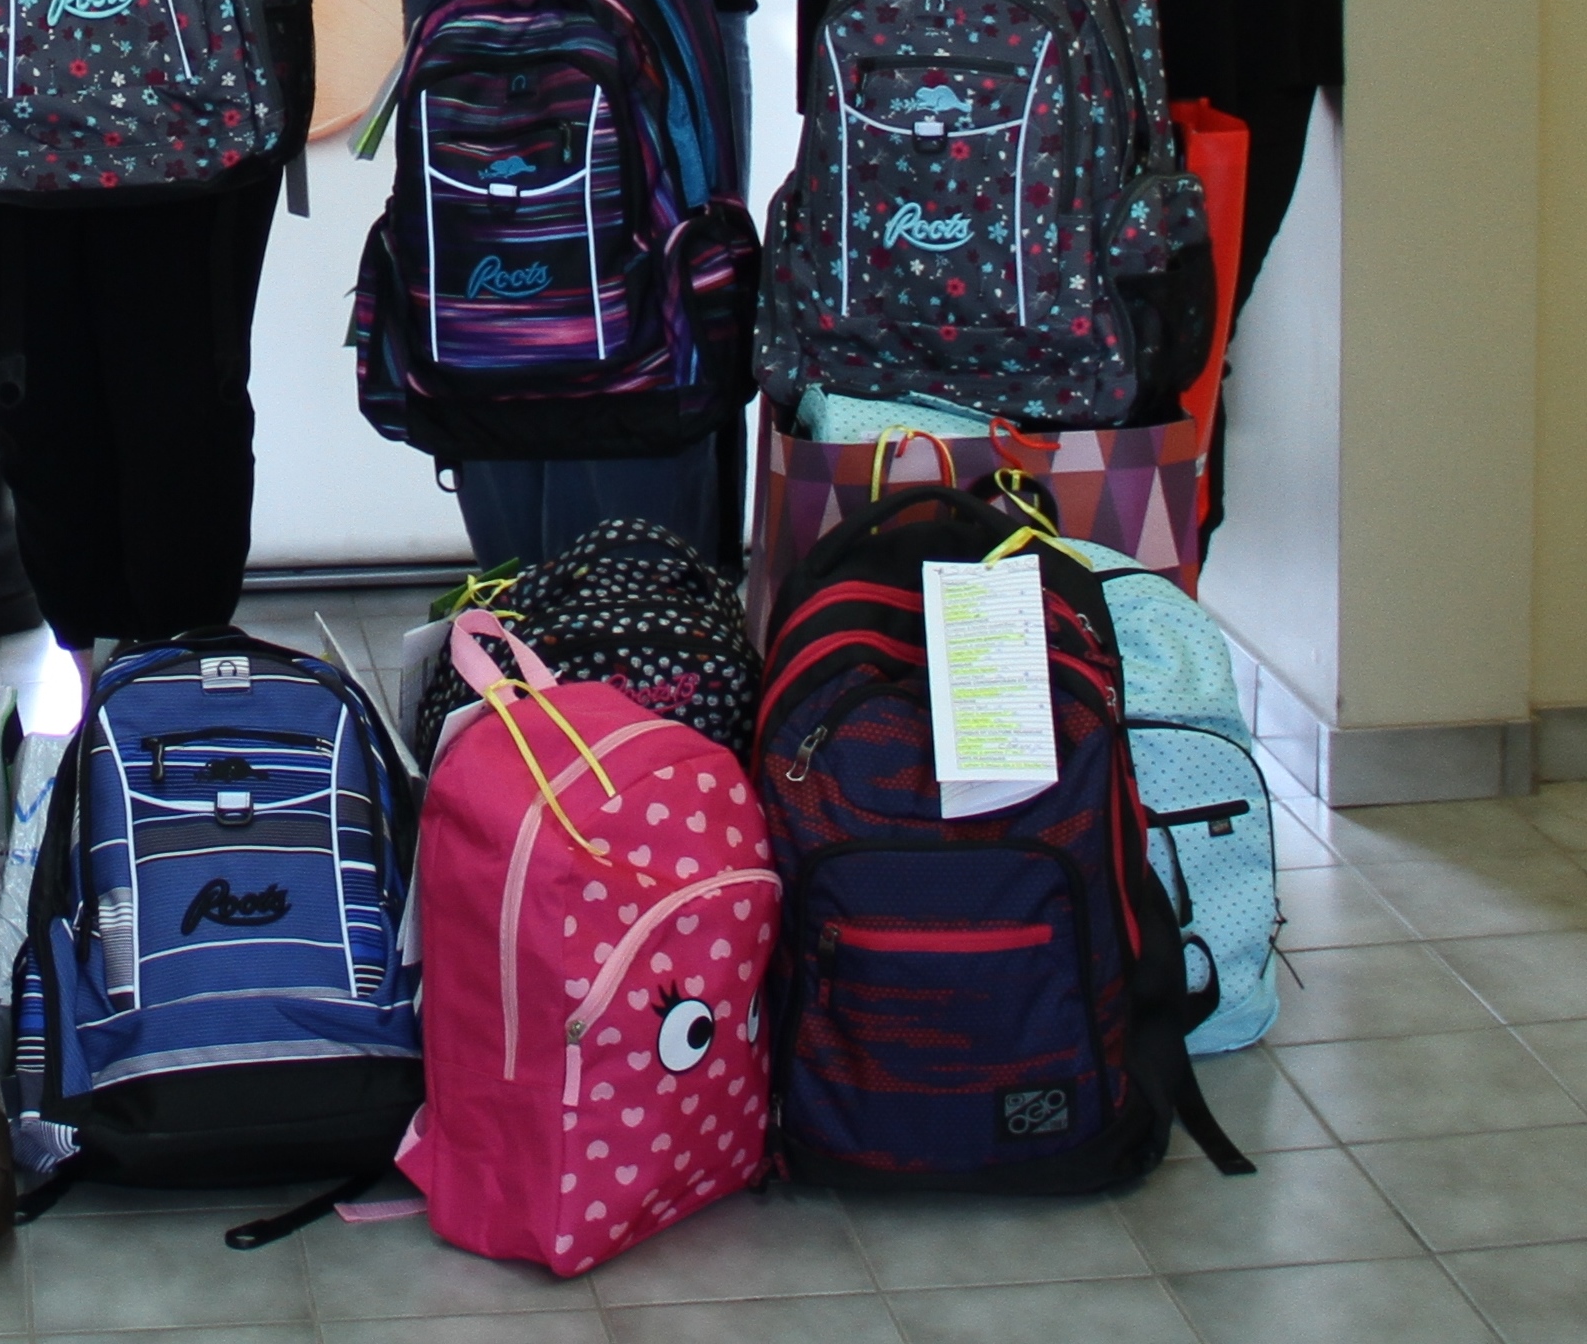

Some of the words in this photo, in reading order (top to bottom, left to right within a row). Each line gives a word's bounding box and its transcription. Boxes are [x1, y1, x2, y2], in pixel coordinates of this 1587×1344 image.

[882, 202, 975, 250] Roots
[467, 255, 553, 299] Roots
[180, 877, 293, 937] Roots
